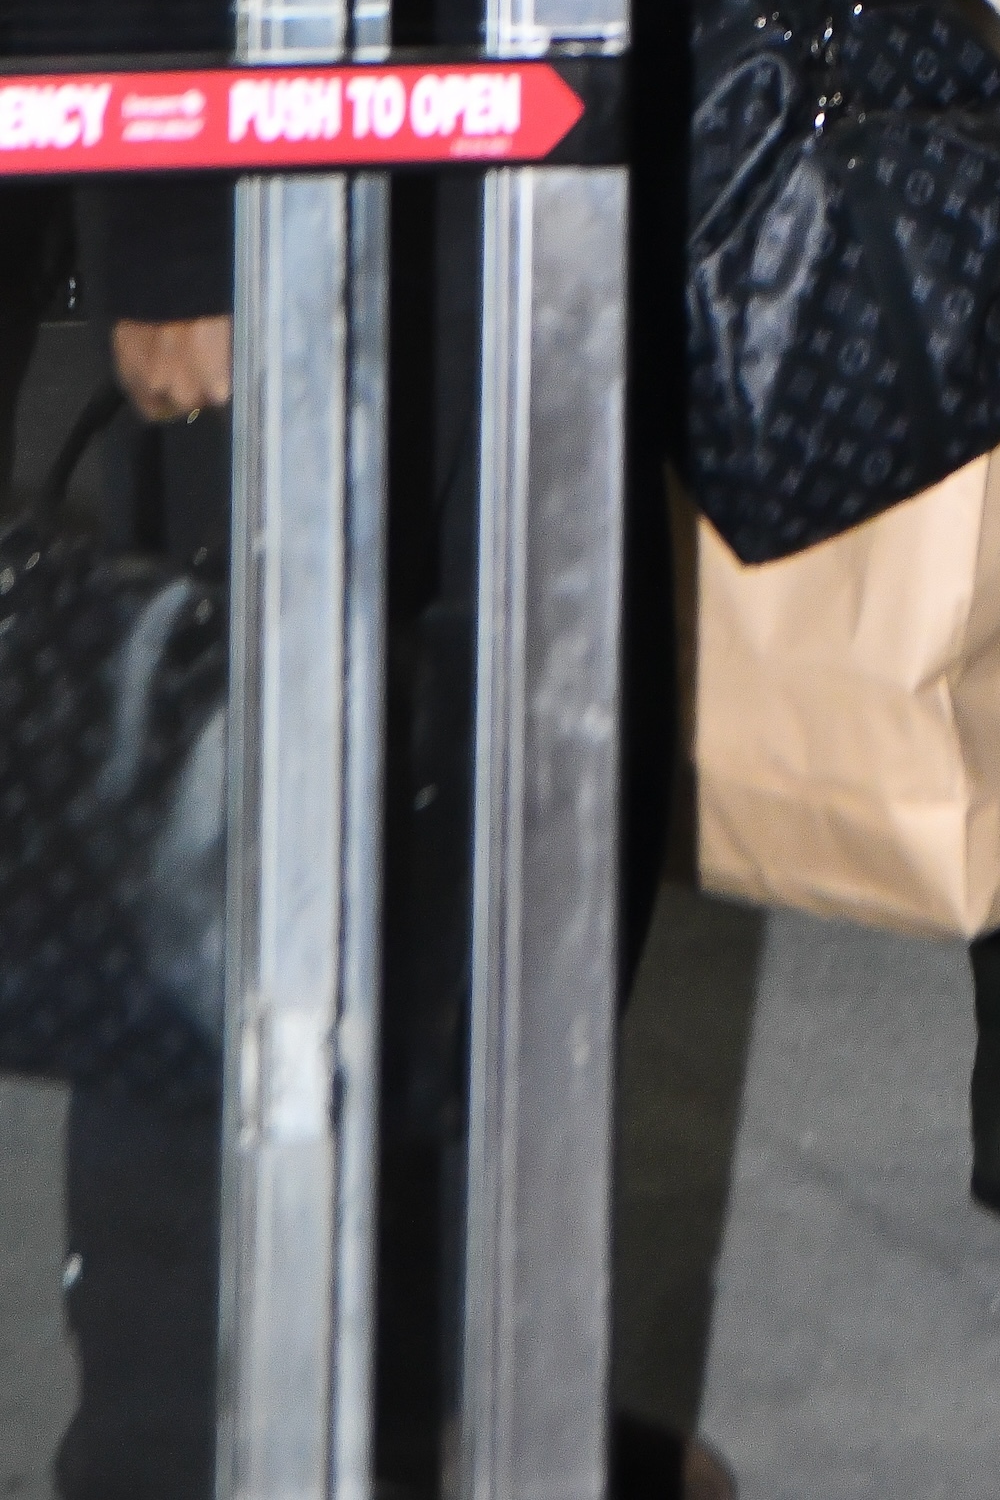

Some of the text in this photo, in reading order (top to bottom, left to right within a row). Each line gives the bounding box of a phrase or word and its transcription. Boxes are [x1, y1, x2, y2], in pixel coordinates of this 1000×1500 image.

[228, 77, 343, 142] PUSH
[345, 75, 406, 138] TO
[409, 73, 521, 137] OPEN
